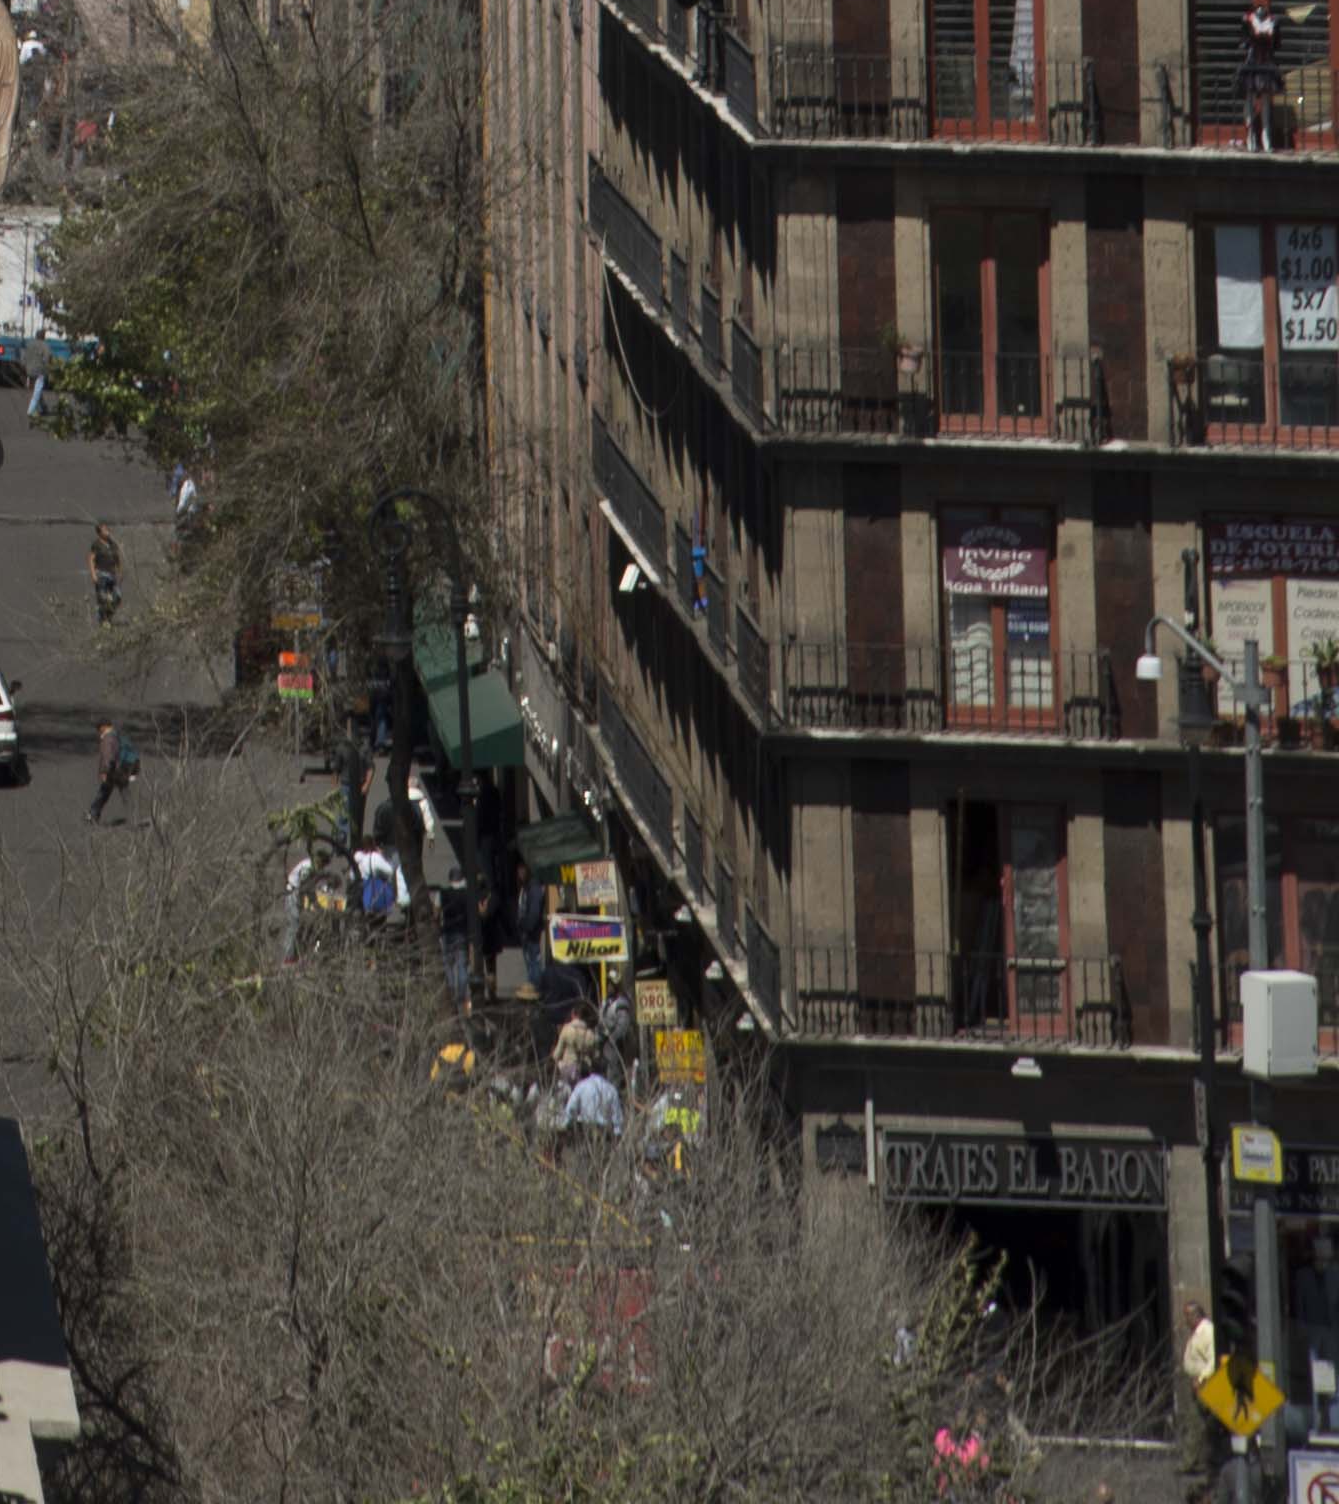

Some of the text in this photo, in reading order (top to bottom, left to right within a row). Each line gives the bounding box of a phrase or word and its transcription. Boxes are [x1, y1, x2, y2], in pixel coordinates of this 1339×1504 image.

[1288, 227, 1323, 250] 4x6
[1280, 256, 1334, 285] $1.00
[1292, 288, 1327, 311] 5x7
[1285, 317, 1337, 343] $1.50
[1226, 524, 1335, 541] ESCUELA
[1210, 540, 1243, 556] DE
[566, 940, 620, 956] Nikon
[639, 993, 664, 1009] ORO
[885, 1141, 1165, 1199] TRAJES EL BARON
